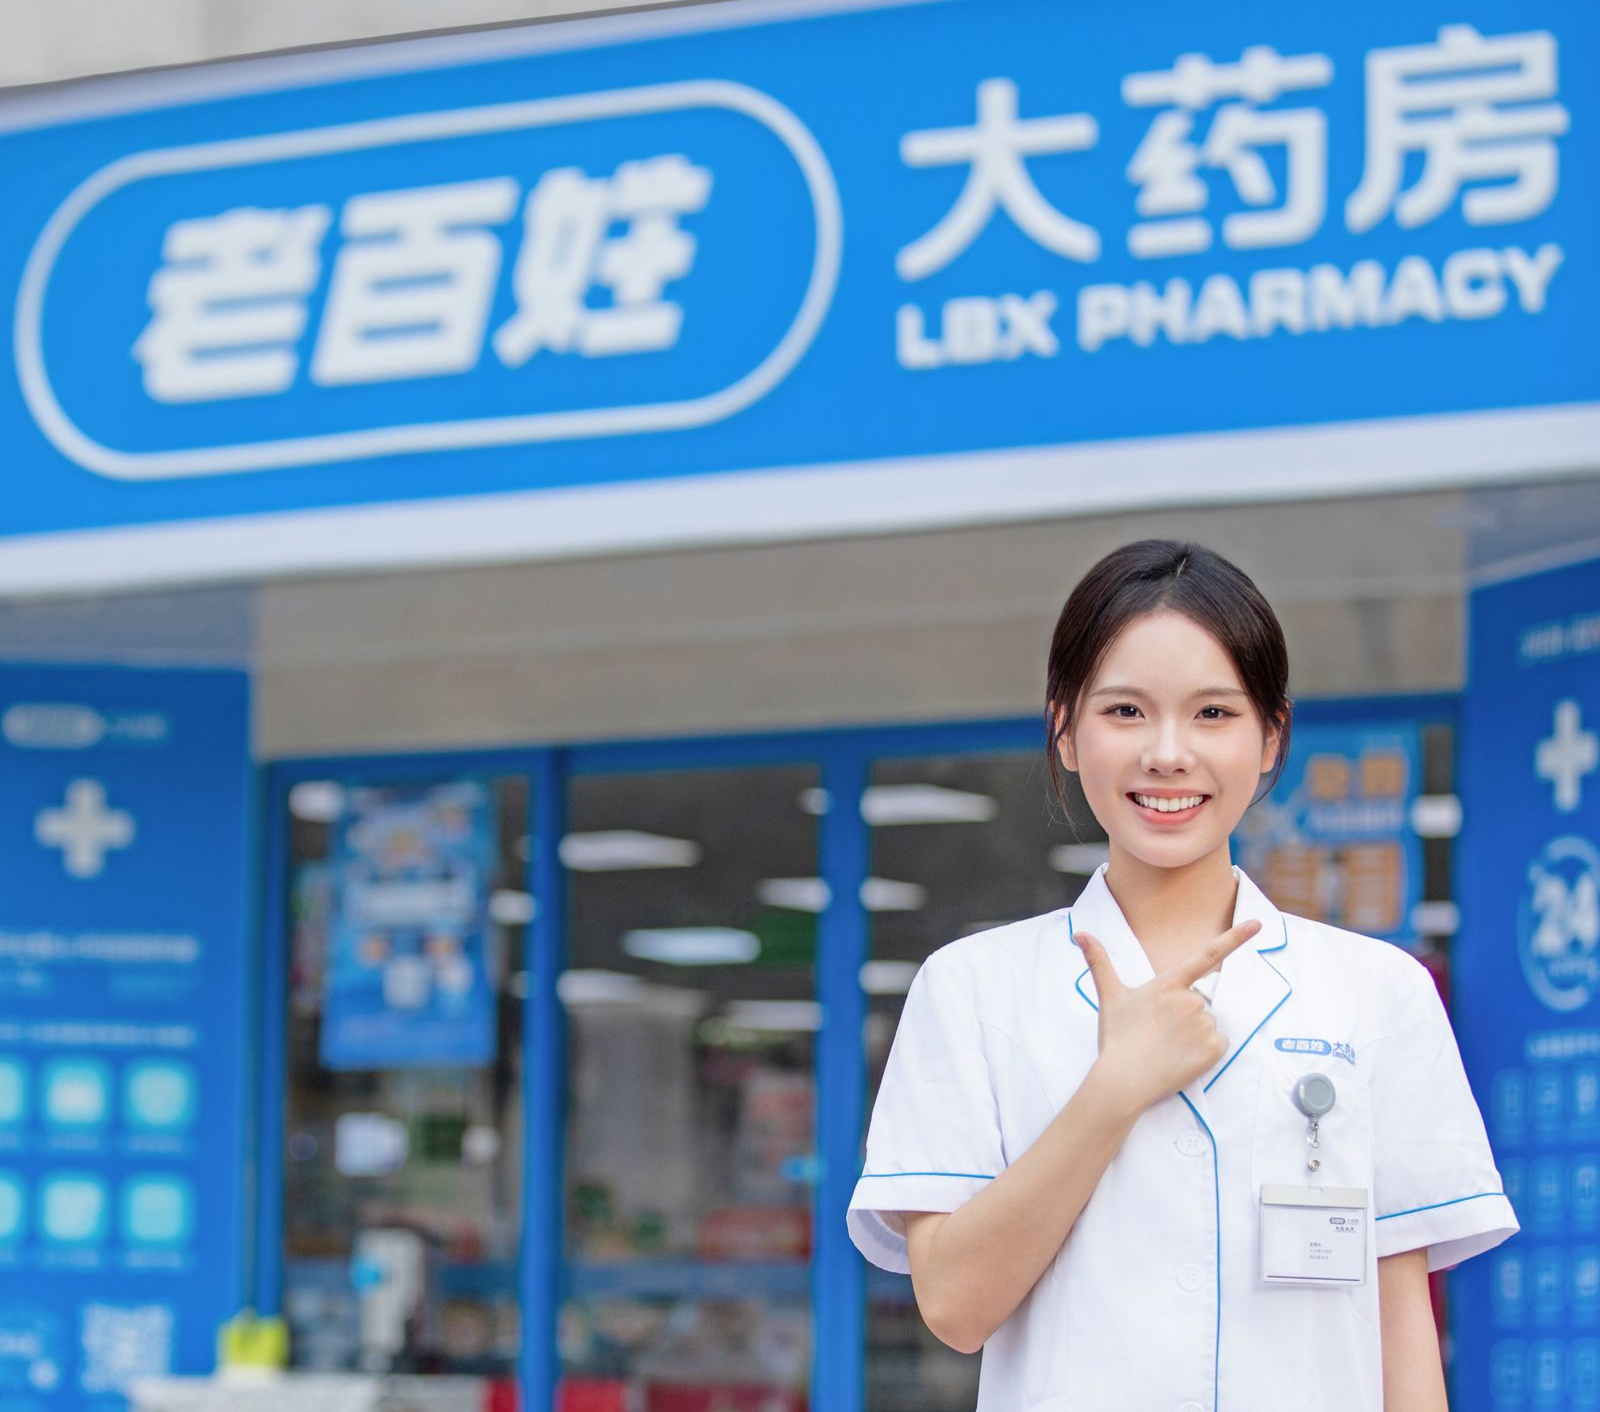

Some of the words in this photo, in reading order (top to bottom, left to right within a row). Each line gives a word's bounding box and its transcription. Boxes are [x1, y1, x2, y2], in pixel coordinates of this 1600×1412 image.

[898, 26, 1568, 279] 大药房
[135, 155, 711, 402] 老百姓
[897, 291, 1058, 369] LBX
[1078, 244, 1563, 352] PHARMACY
